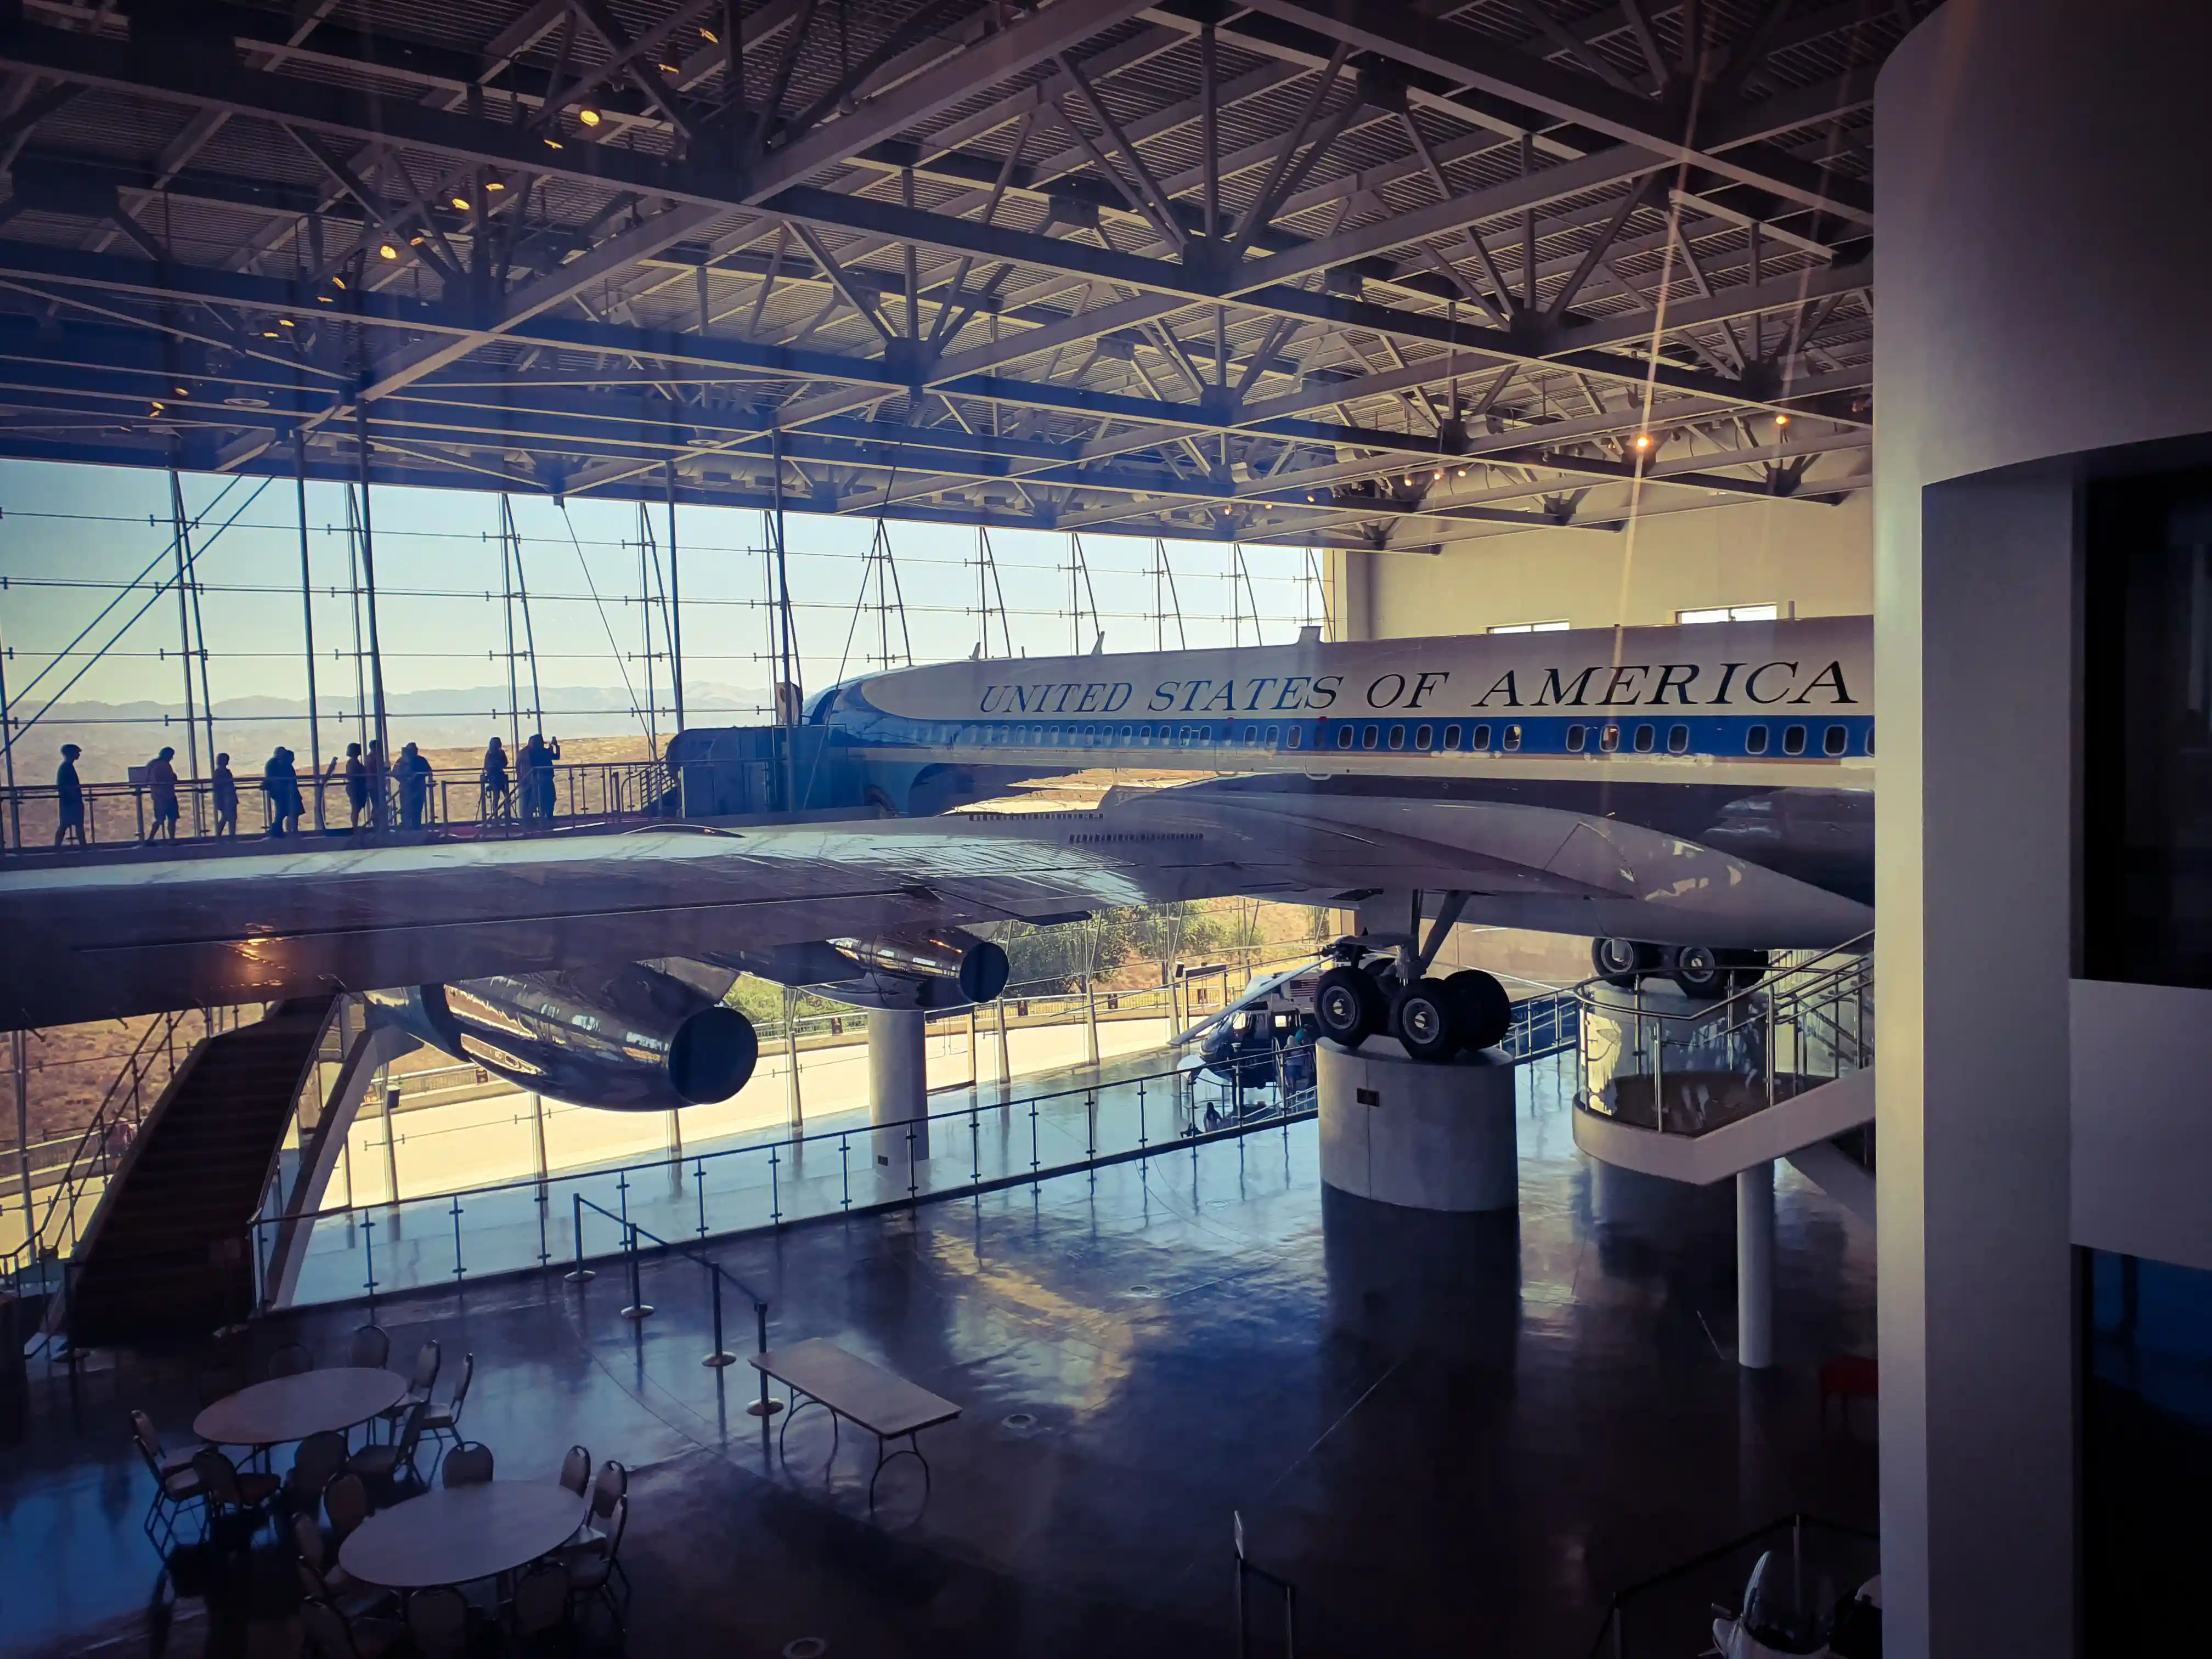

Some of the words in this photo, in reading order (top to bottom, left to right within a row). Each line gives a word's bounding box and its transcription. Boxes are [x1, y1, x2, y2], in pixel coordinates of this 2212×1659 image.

[980, 682, 1133, 713] UNITED
[1147, 675, 1344, 712] STATES
[1367, 672, 1450, 708] OF
[1470, 659, 1859, 708] AMERICA
